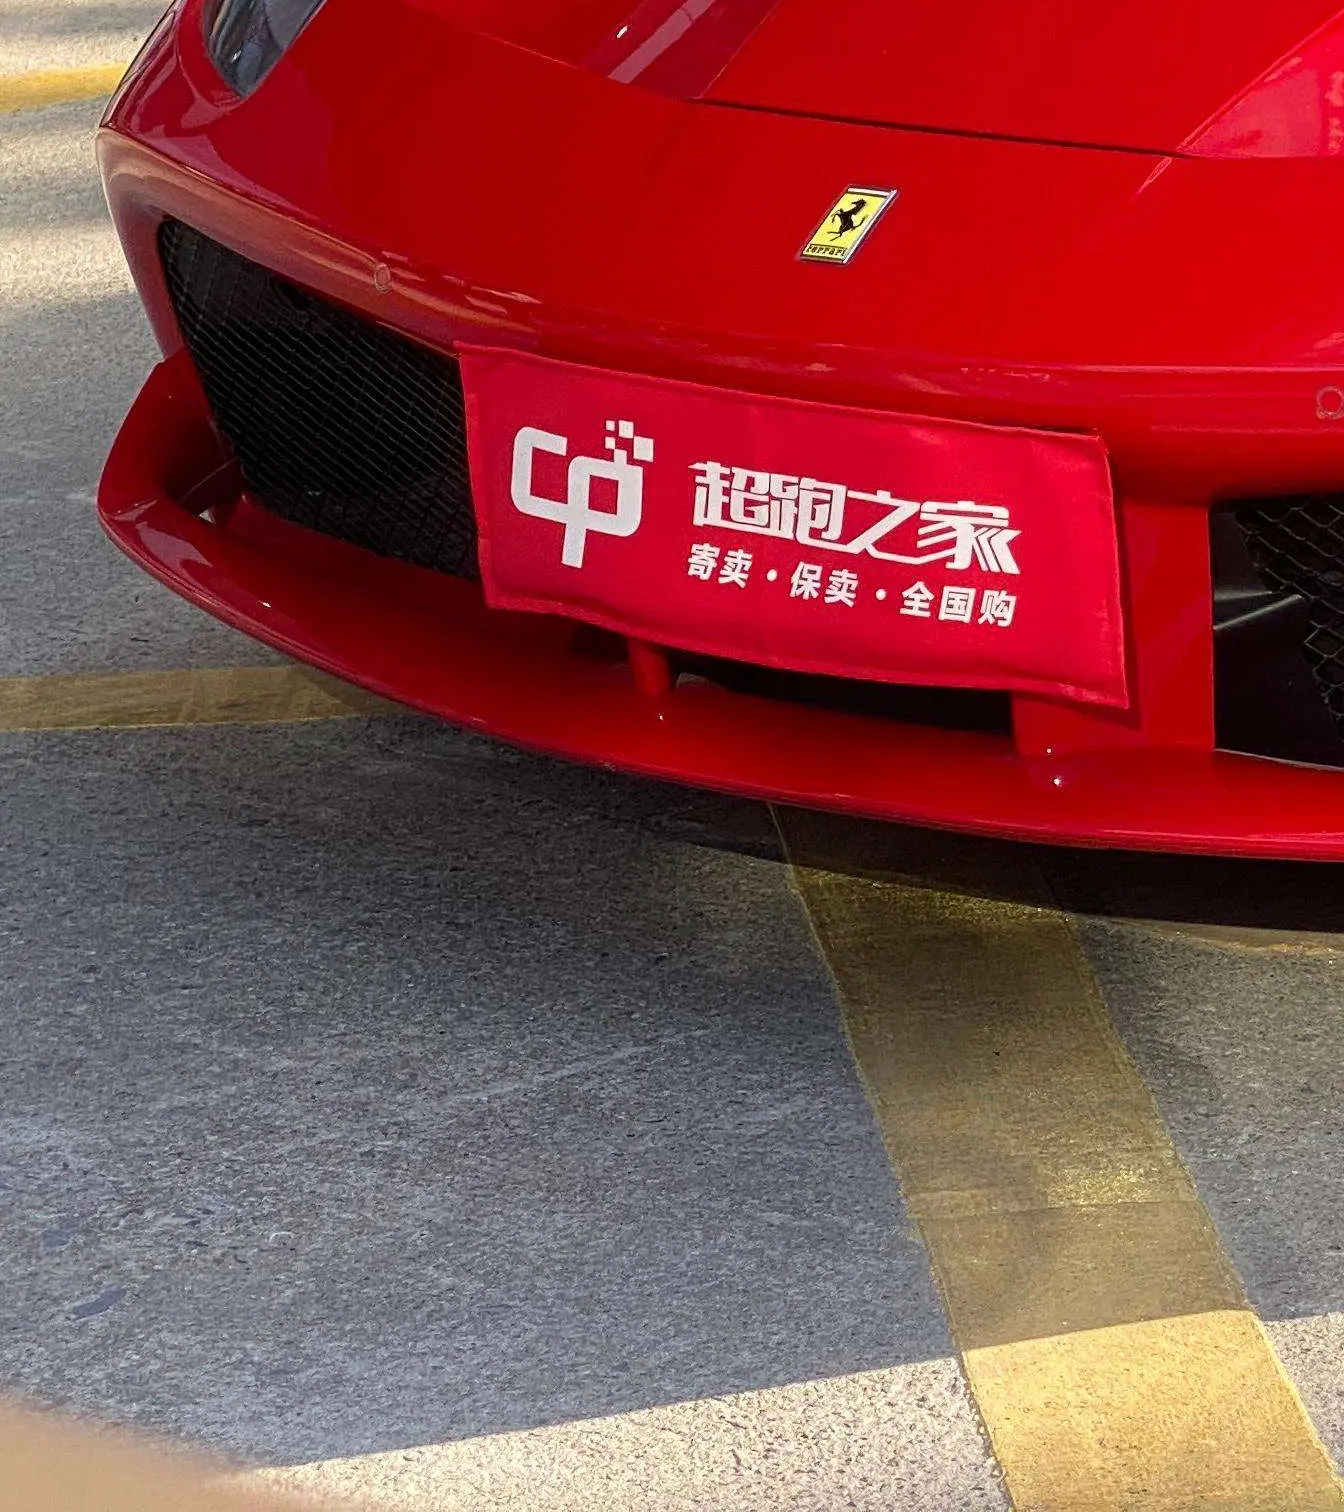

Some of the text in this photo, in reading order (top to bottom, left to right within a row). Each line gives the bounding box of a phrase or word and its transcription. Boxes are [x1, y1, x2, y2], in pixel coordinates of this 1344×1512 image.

[806, 245, 848, 257] Ferrari
[688, 461, 1022, 574] 超跑之家
